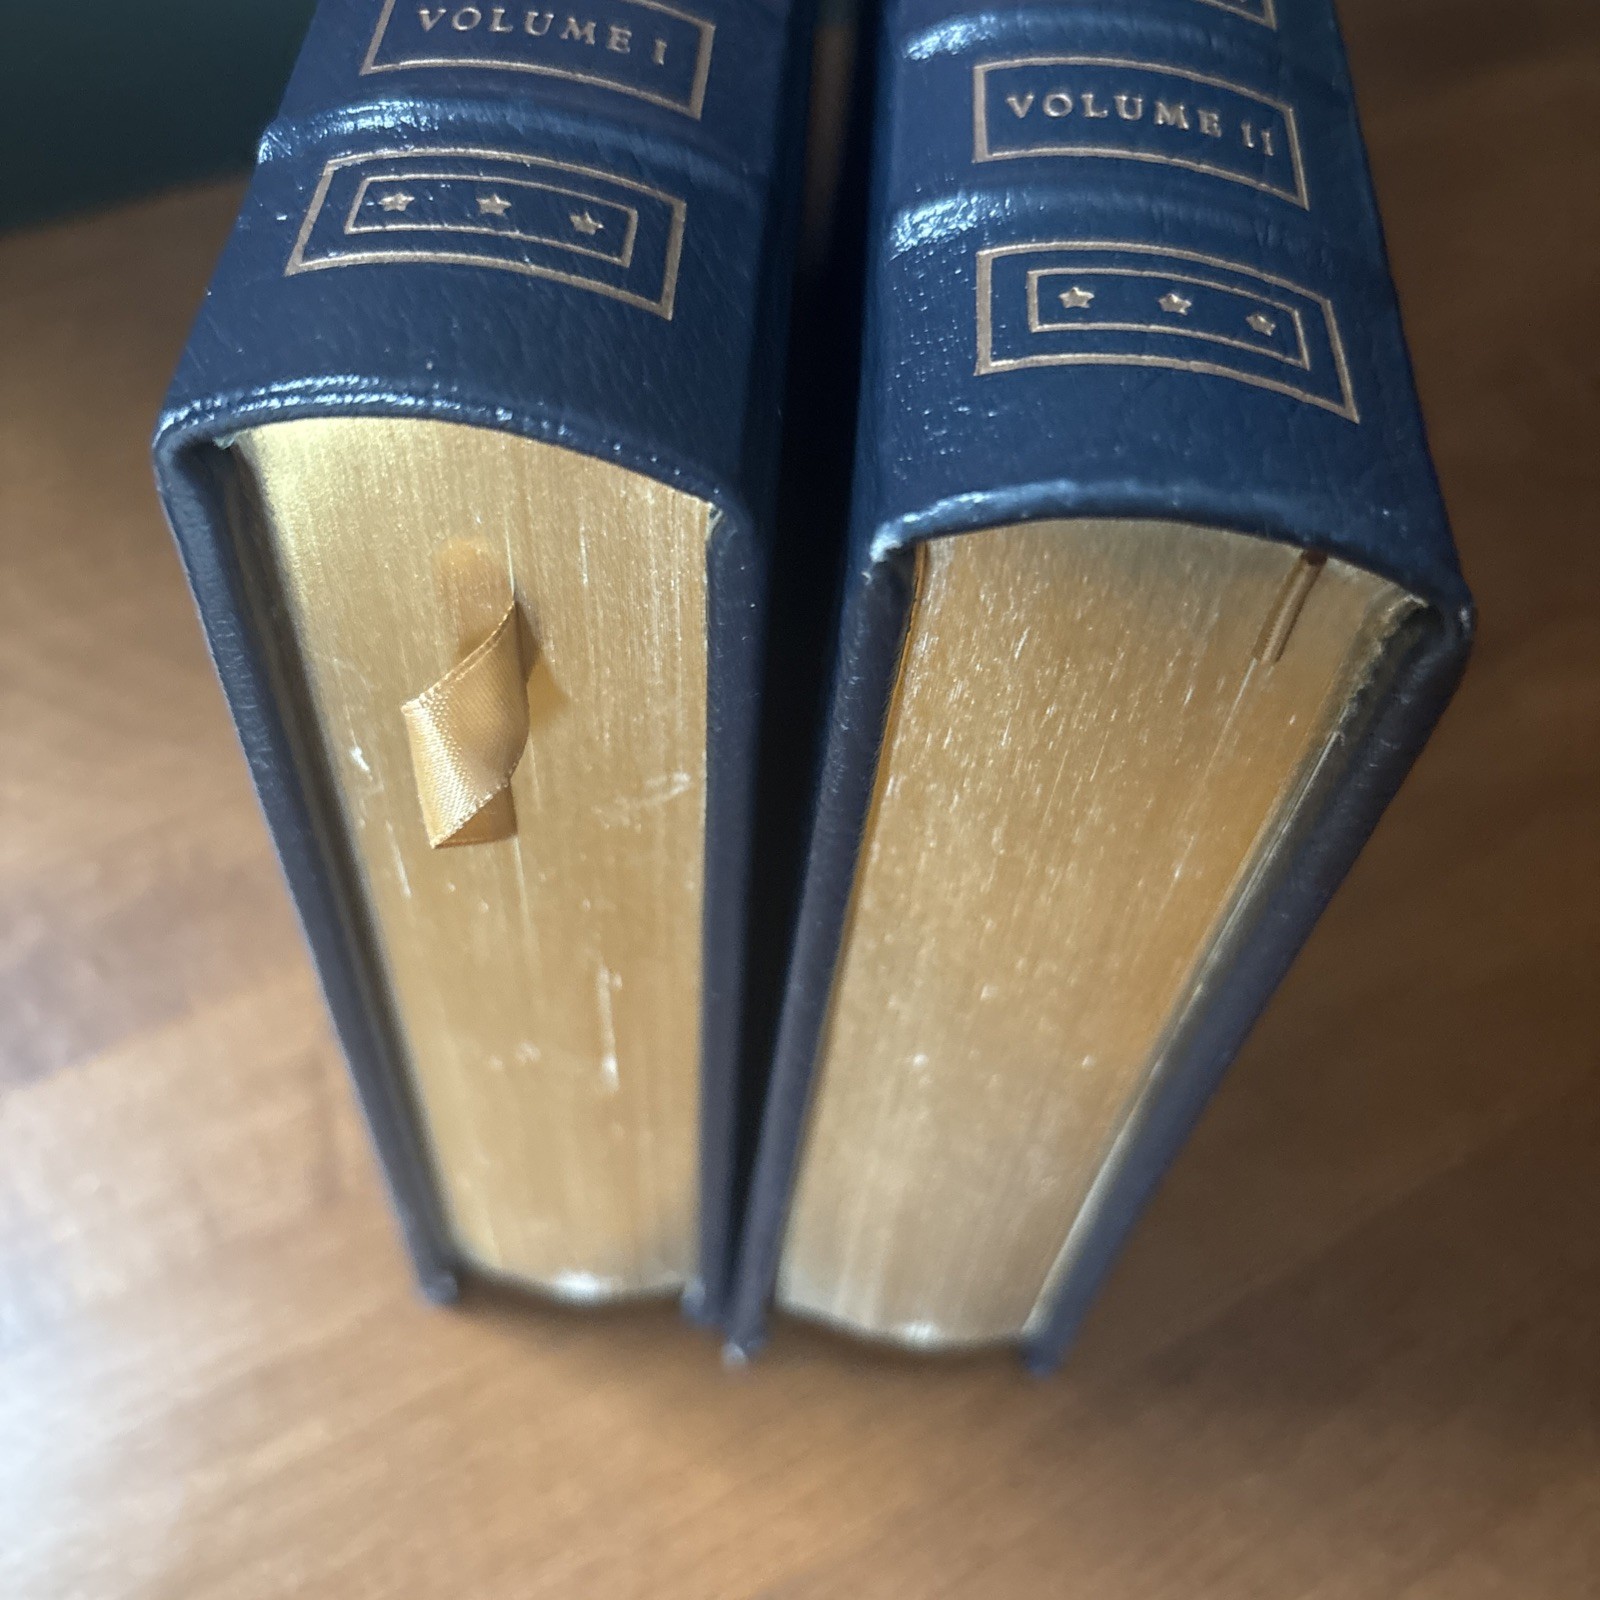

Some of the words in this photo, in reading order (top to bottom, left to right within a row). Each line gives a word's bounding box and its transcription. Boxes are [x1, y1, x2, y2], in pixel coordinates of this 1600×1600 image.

[418, 7, 632, 53] VOLUME
[653, 38, 668, 66] I
[1006, 92, 1222, 138] VOLUME
[1241, 119, 1274, 157] II
